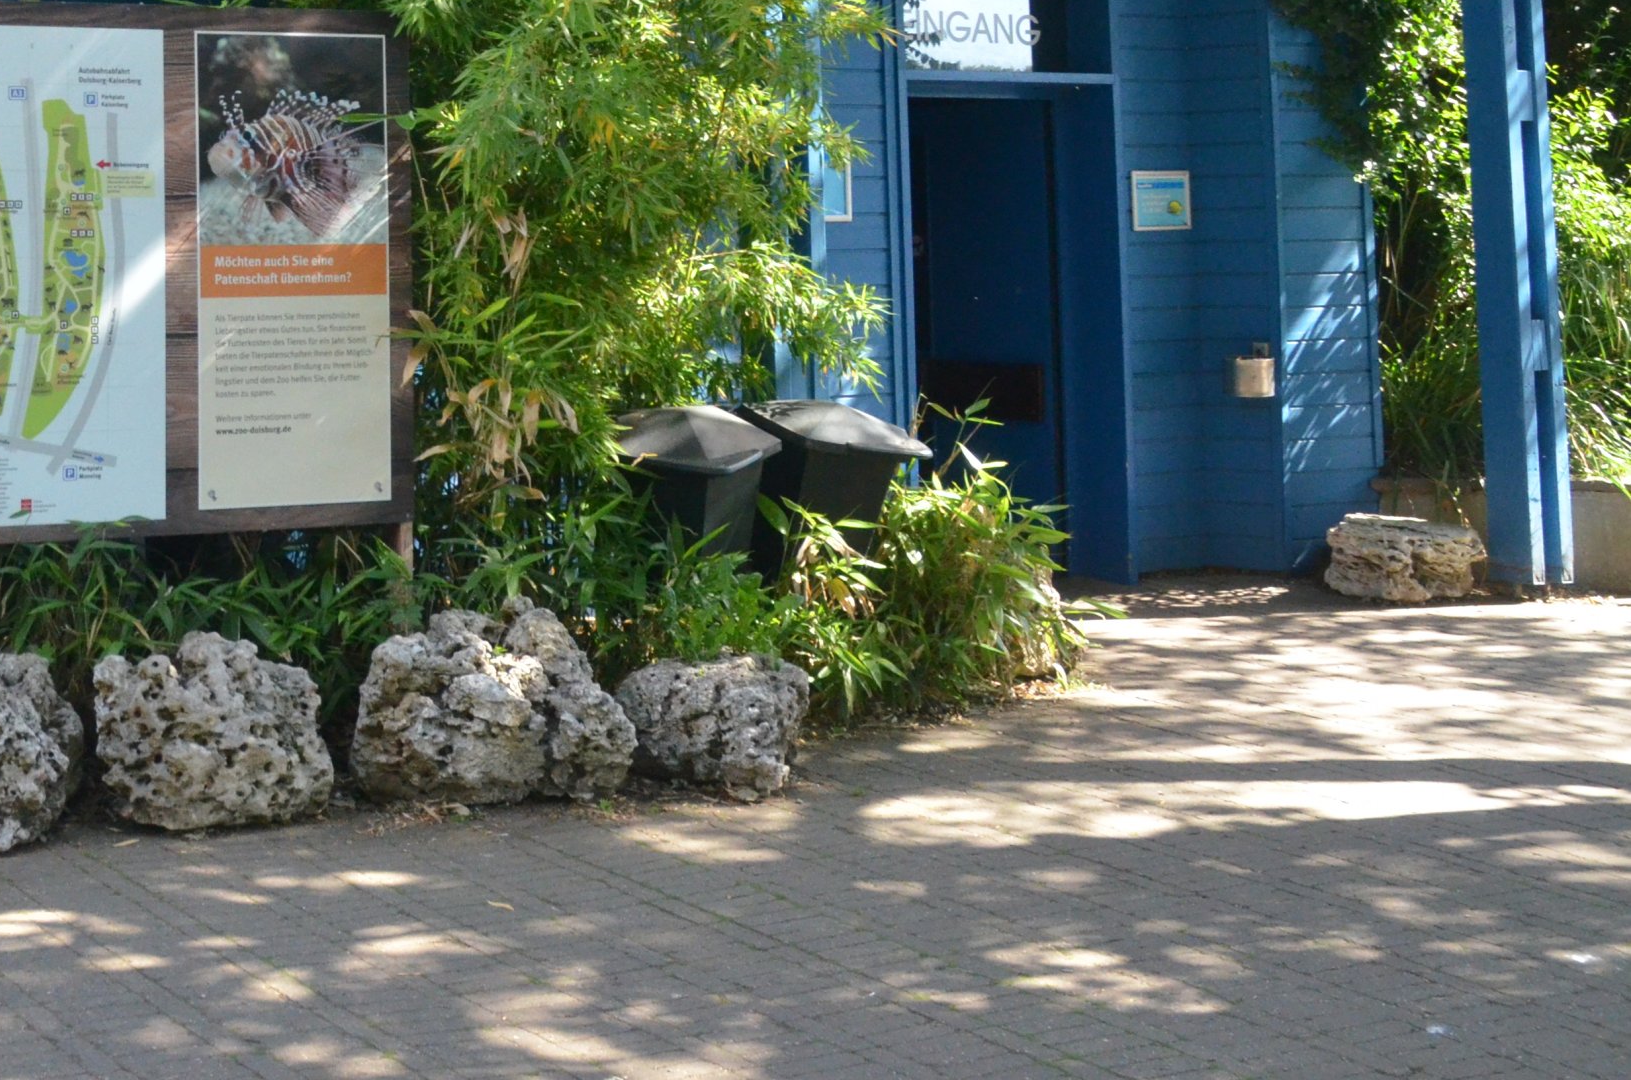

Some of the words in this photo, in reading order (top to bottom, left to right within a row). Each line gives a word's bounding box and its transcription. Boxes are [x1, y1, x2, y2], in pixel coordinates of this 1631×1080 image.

[214, 256, 261, 268] Möchten
[264, 256, 288, 267] auch
[292, 256, 308, 266] Sie
[311, 254, 334, 266] eine
[214, 272, 278, 285] Patenschaft
[281, 272, 352, 284] übernehmen?
[216, 425, 292, 436] www.zoo-duisburg.de
